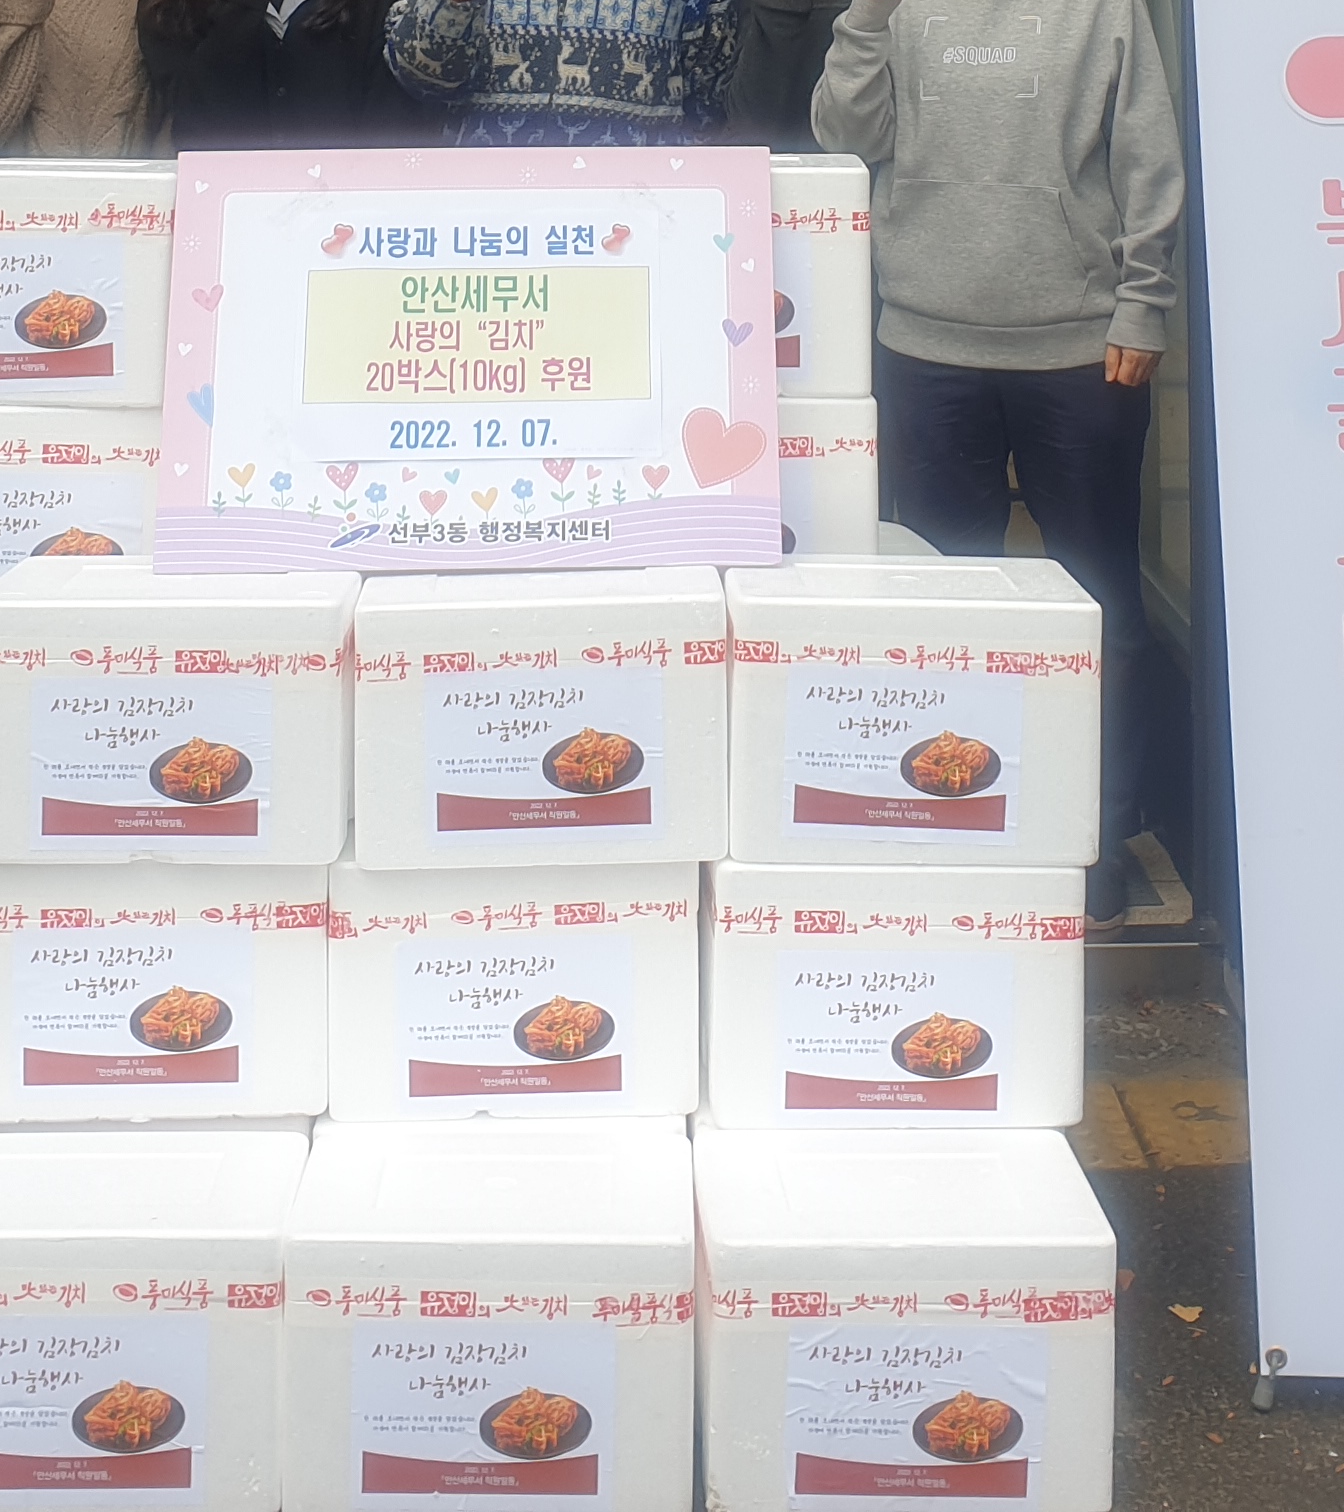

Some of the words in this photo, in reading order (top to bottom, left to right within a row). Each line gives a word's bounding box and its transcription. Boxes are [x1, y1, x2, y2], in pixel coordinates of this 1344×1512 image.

[942, 45, 1017, 66] #SQUAD
[784, 207, 842, 233] 풍미식품
[358, 226, 438, 258] 사랑과
[453, 225, 529, 257] 나눔의
[544, 224, 595, 256] 실천
[400, 274, 549, 314] 안산세무서
[389, 319, 461, 353] 사랑의
[540, 356, 592, 392] 후원
[389, 419, 458, 449] 2022.
[472, 418, 508, 448] 12.
[521, 418, 558, 447] 07.
[2, 490, 73, 509] 김장김치
[388, 521, 468, 544] 선부3동
[478, 519, 611, 542] 행정복지센터
[96, 644, 163, 675] 풍미식품
[607, 638, 672, 669] 풍미식품
[910, 645, 975, 671] 풍미식품
[50, 696, 109, 715] 사랑의
[117, 695, 194, 718] 김장김치
[442, 689, 500, 710] 사랑의
[508, 687, 585, 710] 김장김치
[805, 686, 863, 704] 사랑의
[870, 686, 946, 710] 김장김치
[84, 726, 160, 748] 나눔행사
[477, 718, 553, 742] 나눔행사
[838, 716, 913, 739] 나눔행사
[477, 901, 543, 930] 풍미식품
[719, 904, 783, 934] 풍미식품
[30, 946, 89, 966] 사랑의
[97, 945, 174, 968] 김장김치
[414, 958, 472, 978] 사랑의
[480, 956, 556, 977] 김장김치
[64, 976, 141, 1000] 나눔행사
[794, 971, 852, 990] 사랑의
[860, 971, 936, 993] 김장김치
[449, 986, 524, 1010] 나눔행사
[828, 1001, 903, 1024] 나눔행사
[140, 1278, 214, 1311] 풍미식품
[335, 1284, 407, 1317] 풍미식품
[37, 1335, 122, 1359] 김장김치
[371, 1343, 435, 1362] 사랑의
[444, 1342, 529, 1365] 김장김치
[808, 1345, 872, 1365] 사랑의
[881, 1345, 964, 1368] 김장김치
[0, 1368, 85, 1394] 나눔행사
[408, 1375, 493, 1399] 나눔행사
[844, 1377, 927, 1402] 나눔행사
